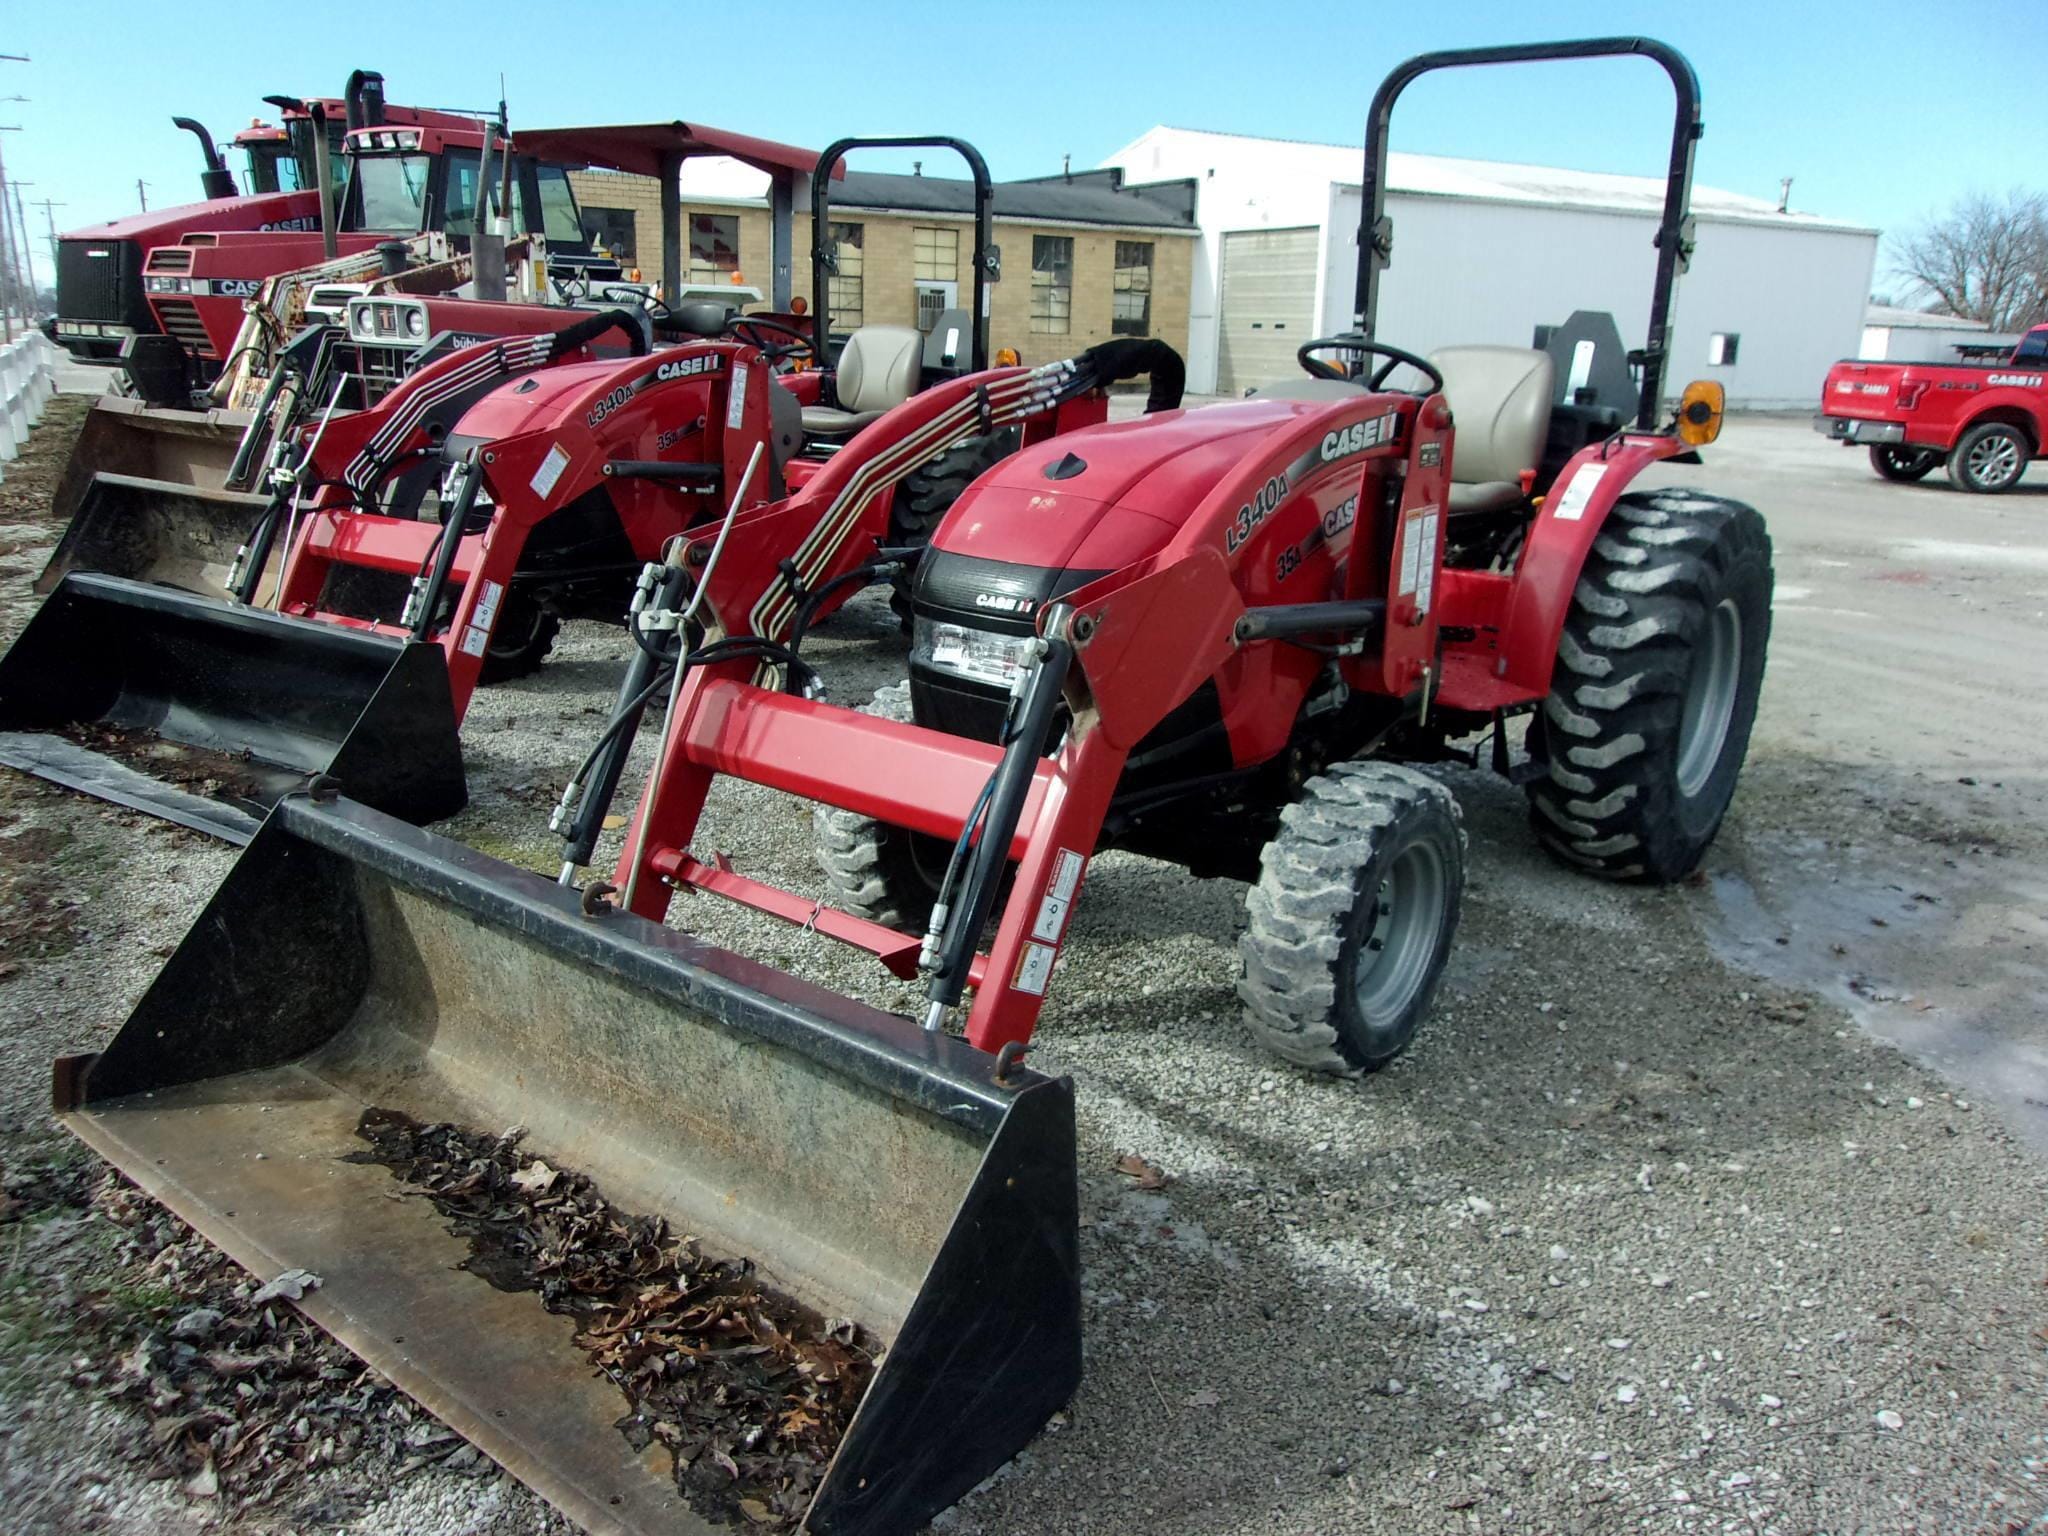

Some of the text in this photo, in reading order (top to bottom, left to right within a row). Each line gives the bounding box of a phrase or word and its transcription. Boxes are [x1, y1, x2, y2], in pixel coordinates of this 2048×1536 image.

[221, 280, 261, 295] CAS
[587, 384, 635, 428] L340A
[1226, 471, 1290, 557] L340A
